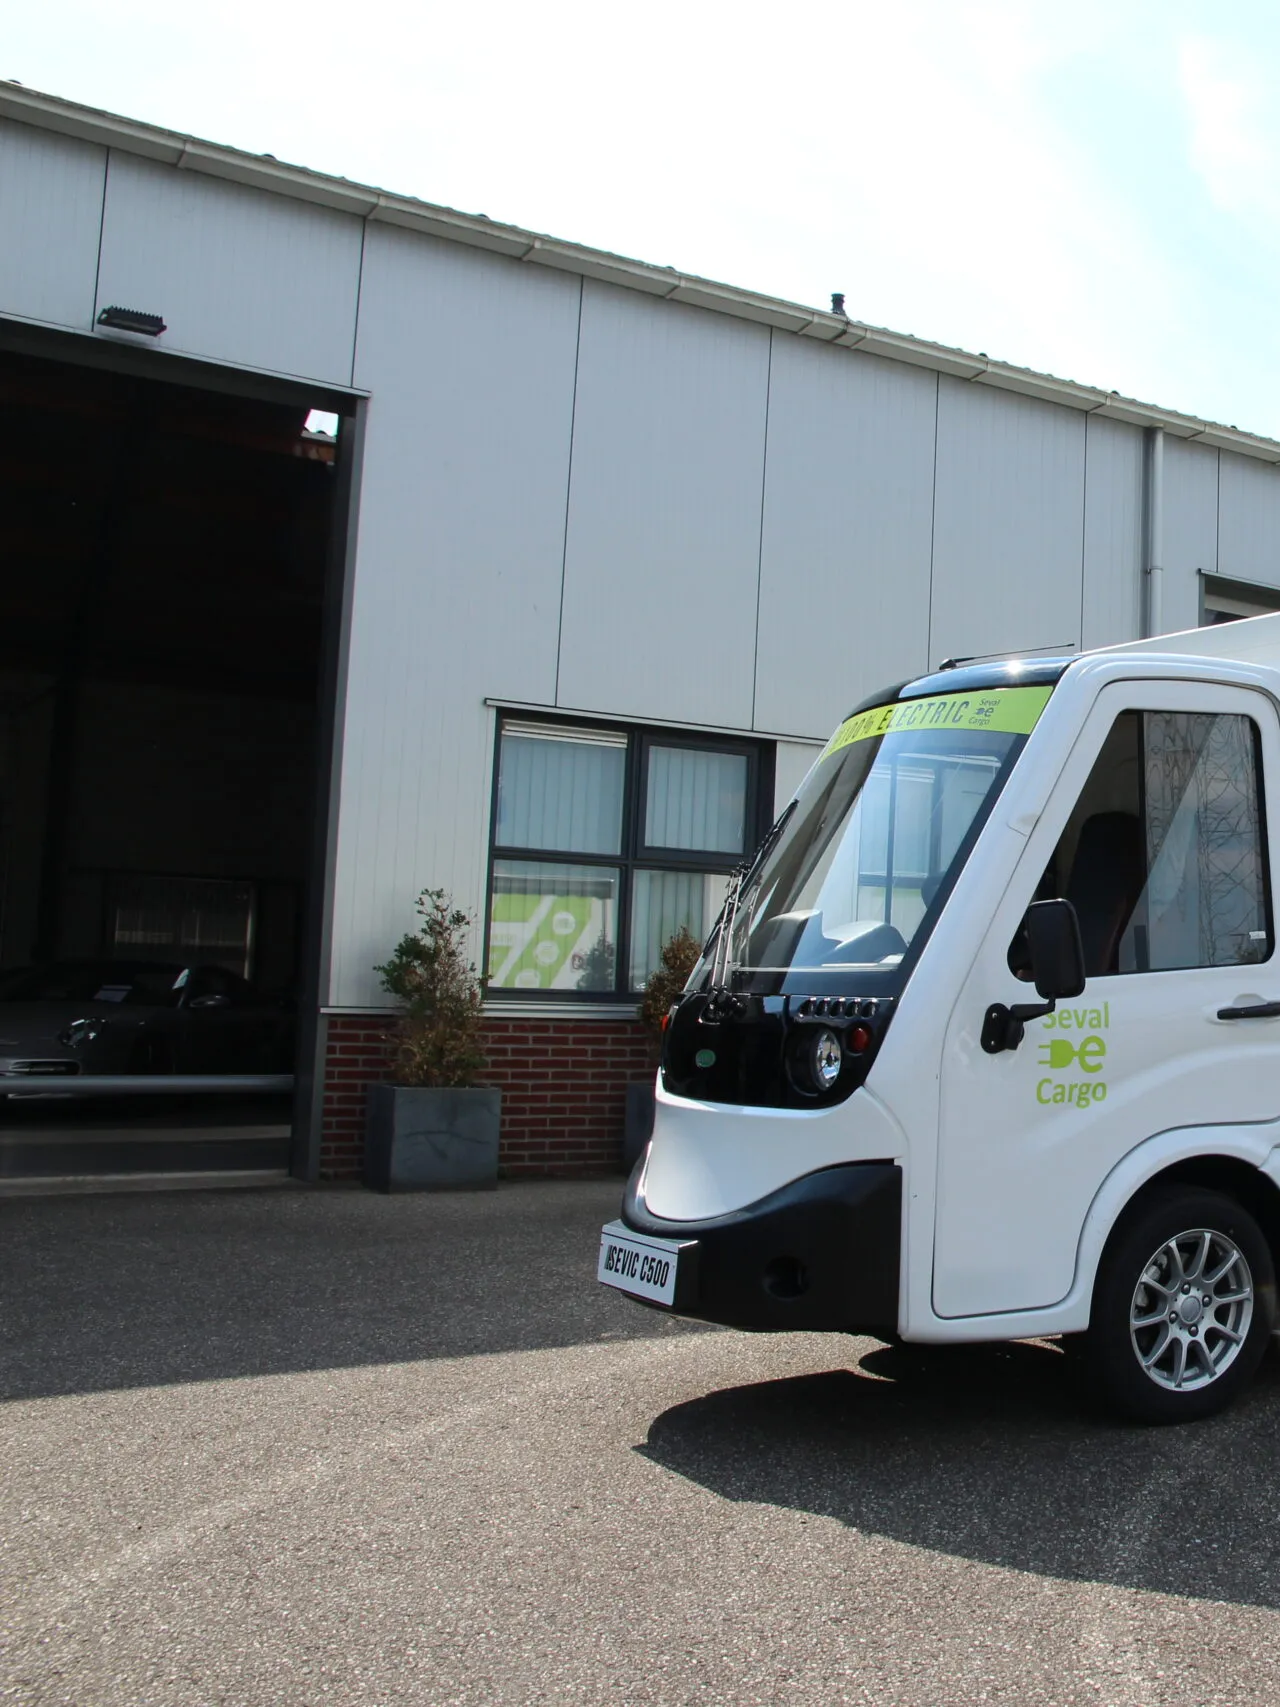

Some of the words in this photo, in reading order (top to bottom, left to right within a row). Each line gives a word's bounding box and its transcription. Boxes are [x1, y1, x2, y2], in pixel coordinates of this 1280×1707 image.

[877, 701, 970, 731] ELECTRIC
[979, 698, 1000, 707] Seval
[968, 717, 990, 726] Cargo
[1042, 1002, 1109, 1029] Seval
[1037, 1078, 1107, 1109] Cargo
[639, 1255, 670, 1288] C500
